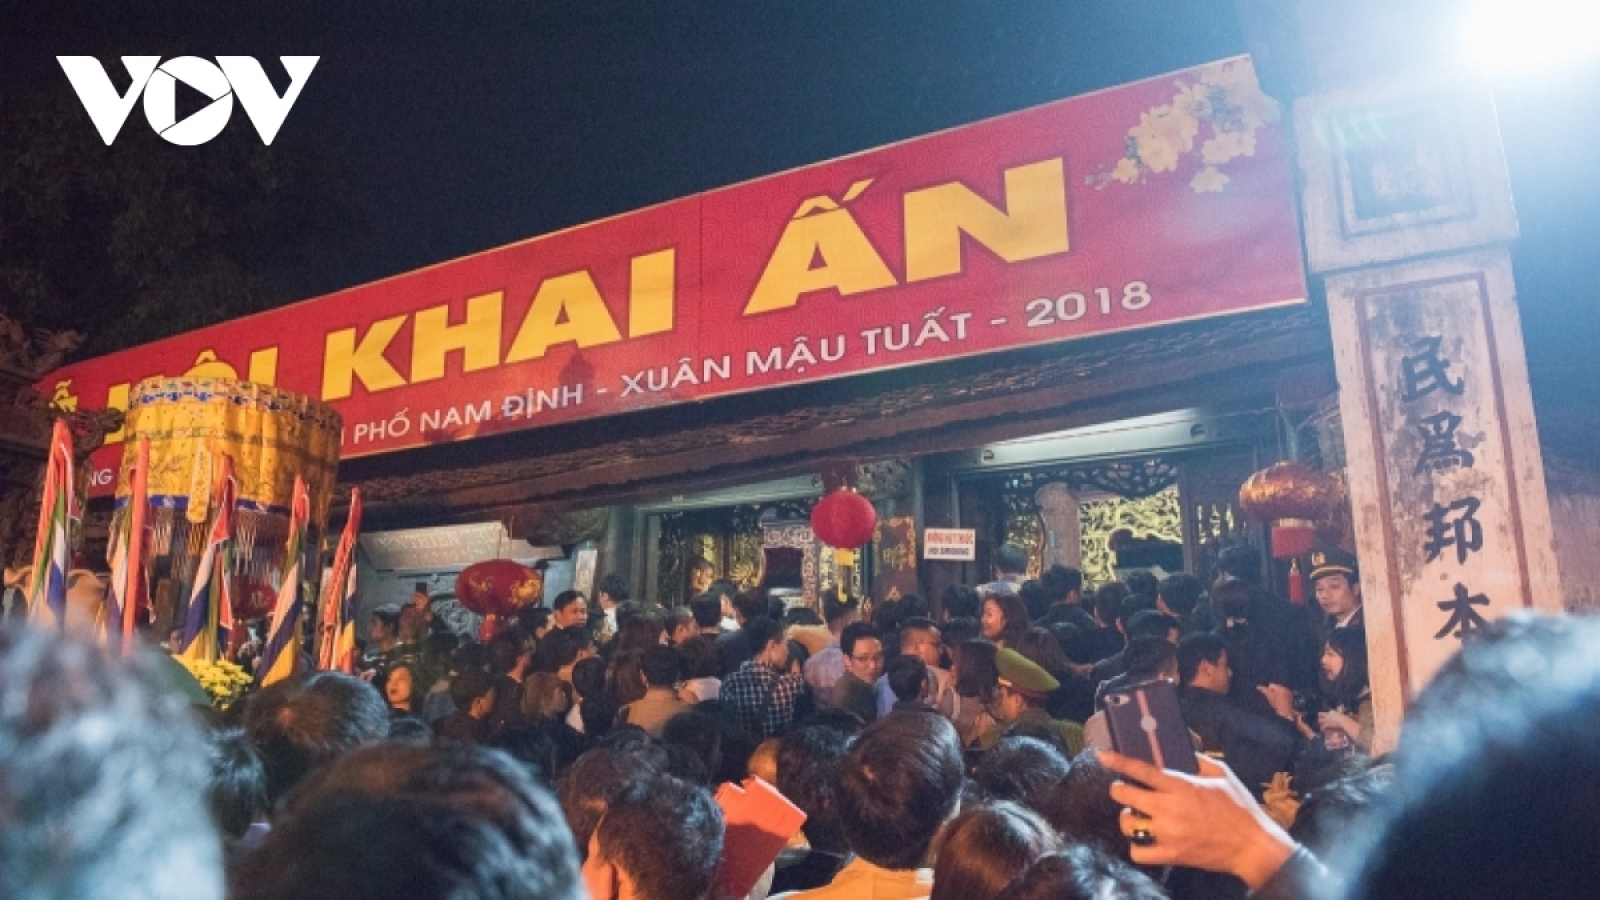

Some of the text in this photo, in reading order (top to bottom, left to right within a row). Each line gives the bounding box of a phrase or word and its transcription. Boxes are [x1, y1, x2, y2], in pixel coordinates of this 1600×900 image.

[321, 247, 676, 401] KHAI
[742, 157, 1070, 316] ẤN
[353, 407, 410, 445] PHỐ
[420, 400, 491, 433] NAM
[501, 383, 584, 419] ĐỊNH
[620, 355, 731, 397] XUÂN
[746, 335, 846, 373] MẬU
[861, 306, 972, 356] TUẤT
[1025, 280, 1152, 328] 2018
